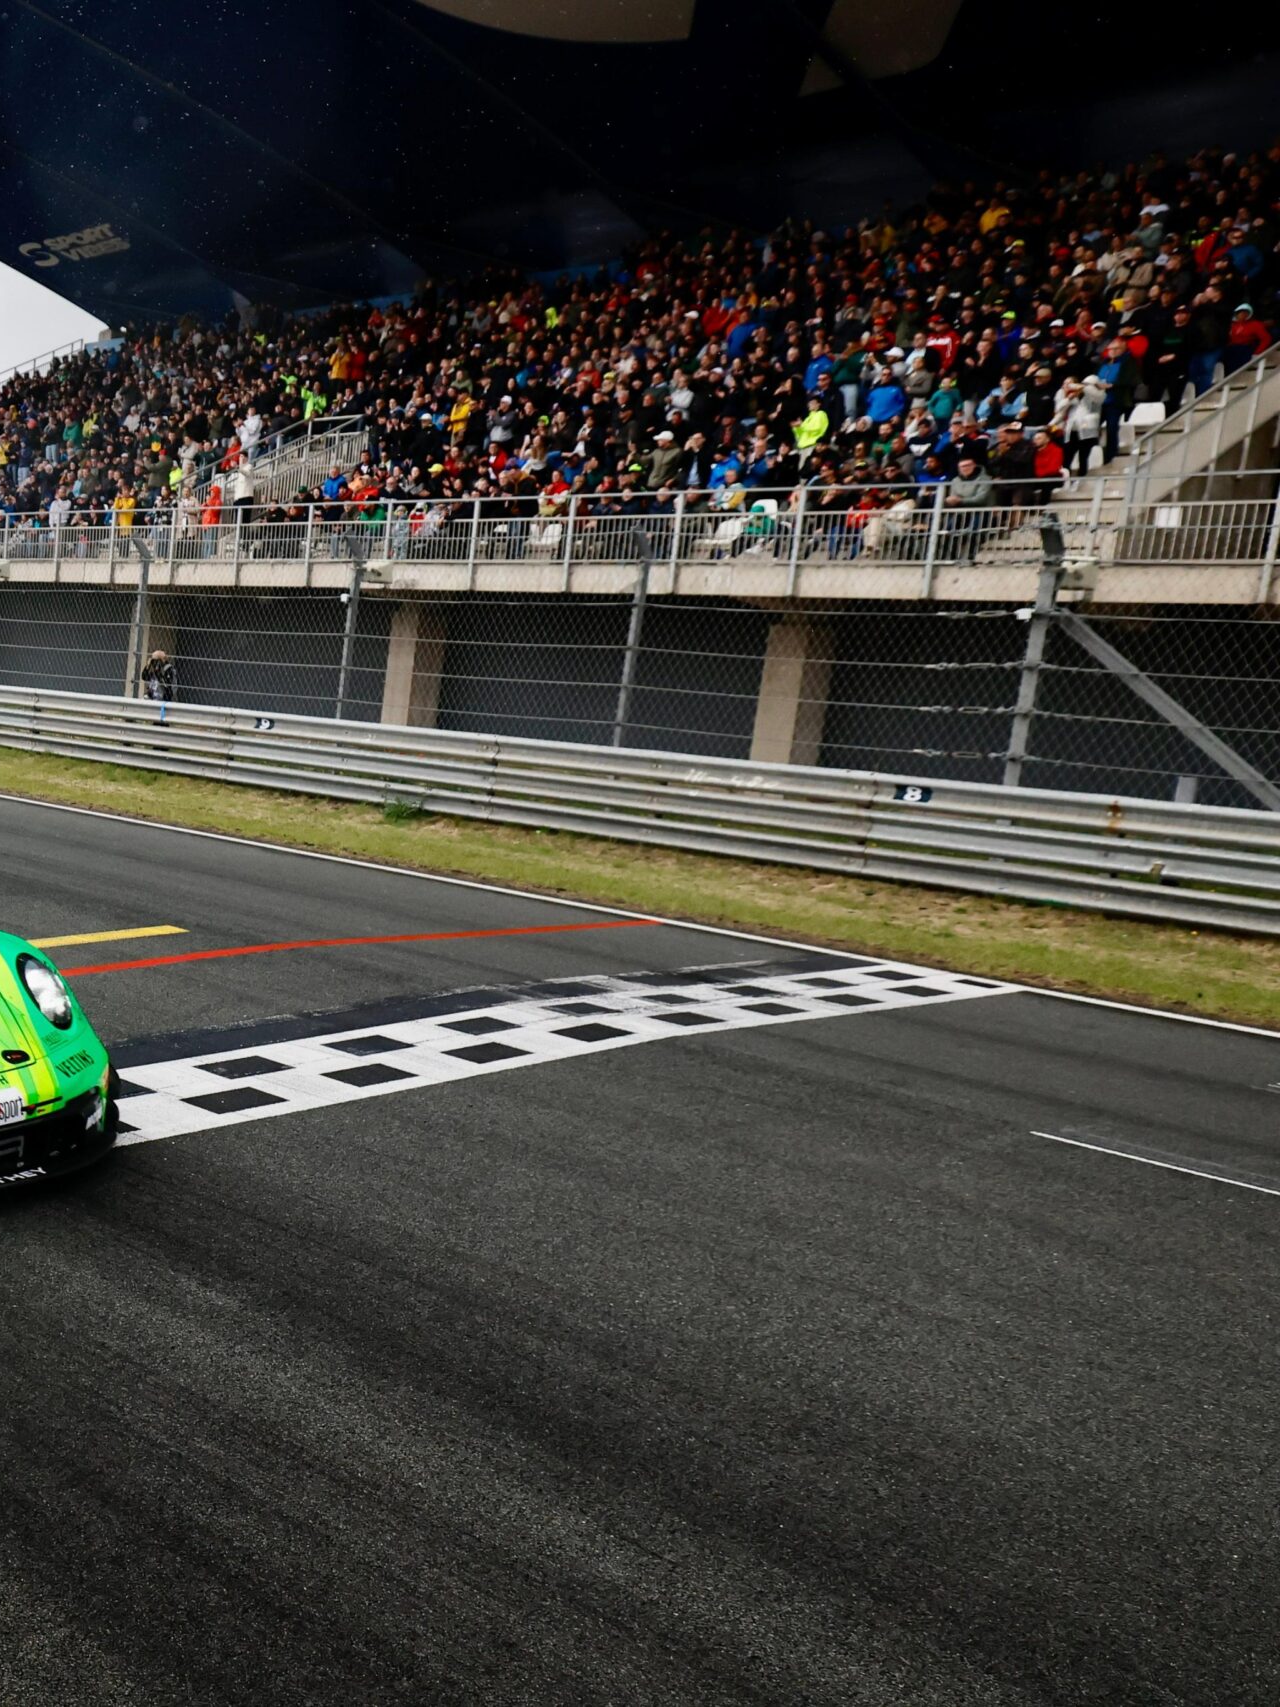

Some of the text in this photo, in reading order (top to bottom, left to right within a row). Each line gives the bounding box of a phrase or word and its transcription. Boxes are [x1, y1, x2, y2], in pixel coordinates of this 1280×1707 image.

[43, 223, 115, 251] SPORT
[260, 718, 271, 729] 9
[903, 786, 923, 801] 8
[55, 1049, 95, 1079] VELTINS
